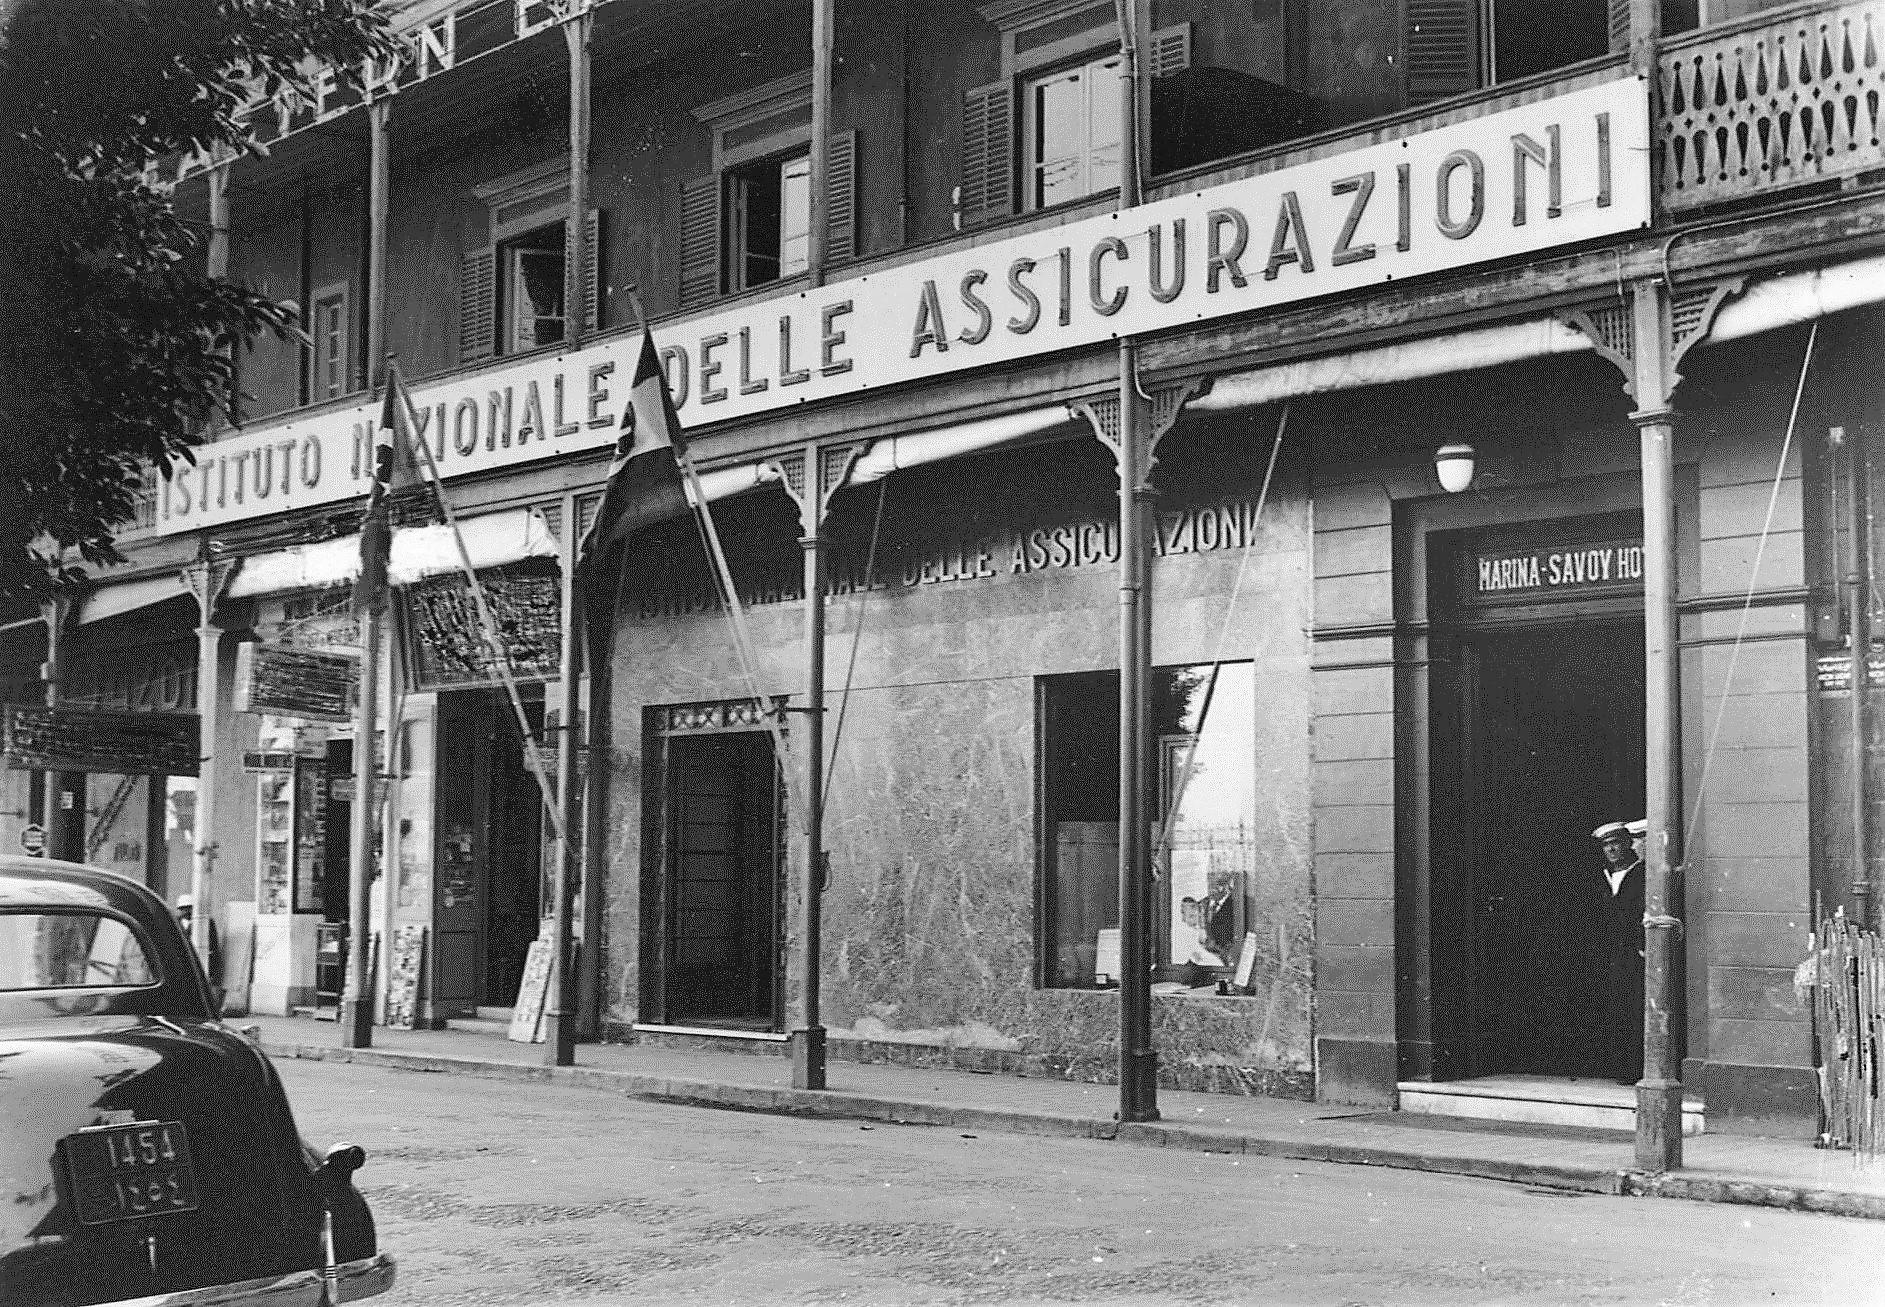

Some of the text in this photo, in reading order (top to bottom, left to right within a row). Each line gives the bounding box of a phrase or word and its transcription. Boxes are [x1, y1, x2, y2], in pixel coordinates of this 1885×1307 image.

[163, 112, 1612, 521] ISTITUTO NZIONALE DELLE ASSICURAZIONI
[1010, 503, 1257, 575] ASSICUAZIONI
[1617, 546, 1645, 580] HO
[107, 1128, 176, 1169] 1454
